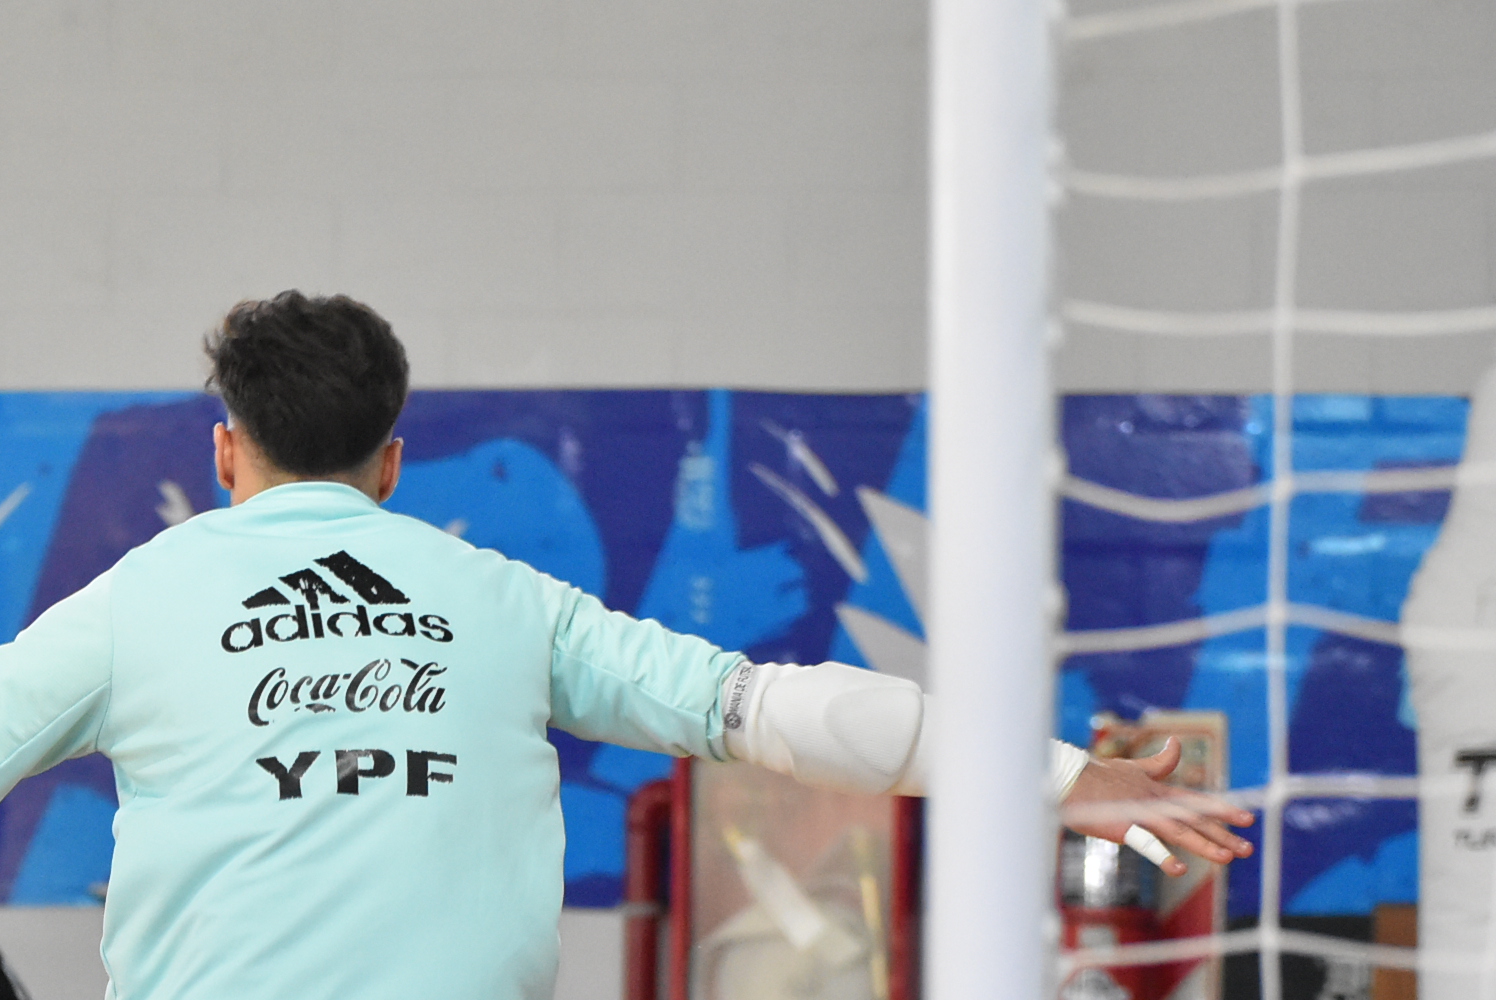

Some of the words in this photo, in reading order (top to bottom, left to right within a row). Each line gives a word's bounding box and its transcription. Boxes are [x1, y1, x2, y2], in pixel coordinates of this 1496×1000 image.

[221, 604, 453, 653] adidas
[248, 658, 448, 726] Coca-Cola
[256, 749, 457, 800] YPF
